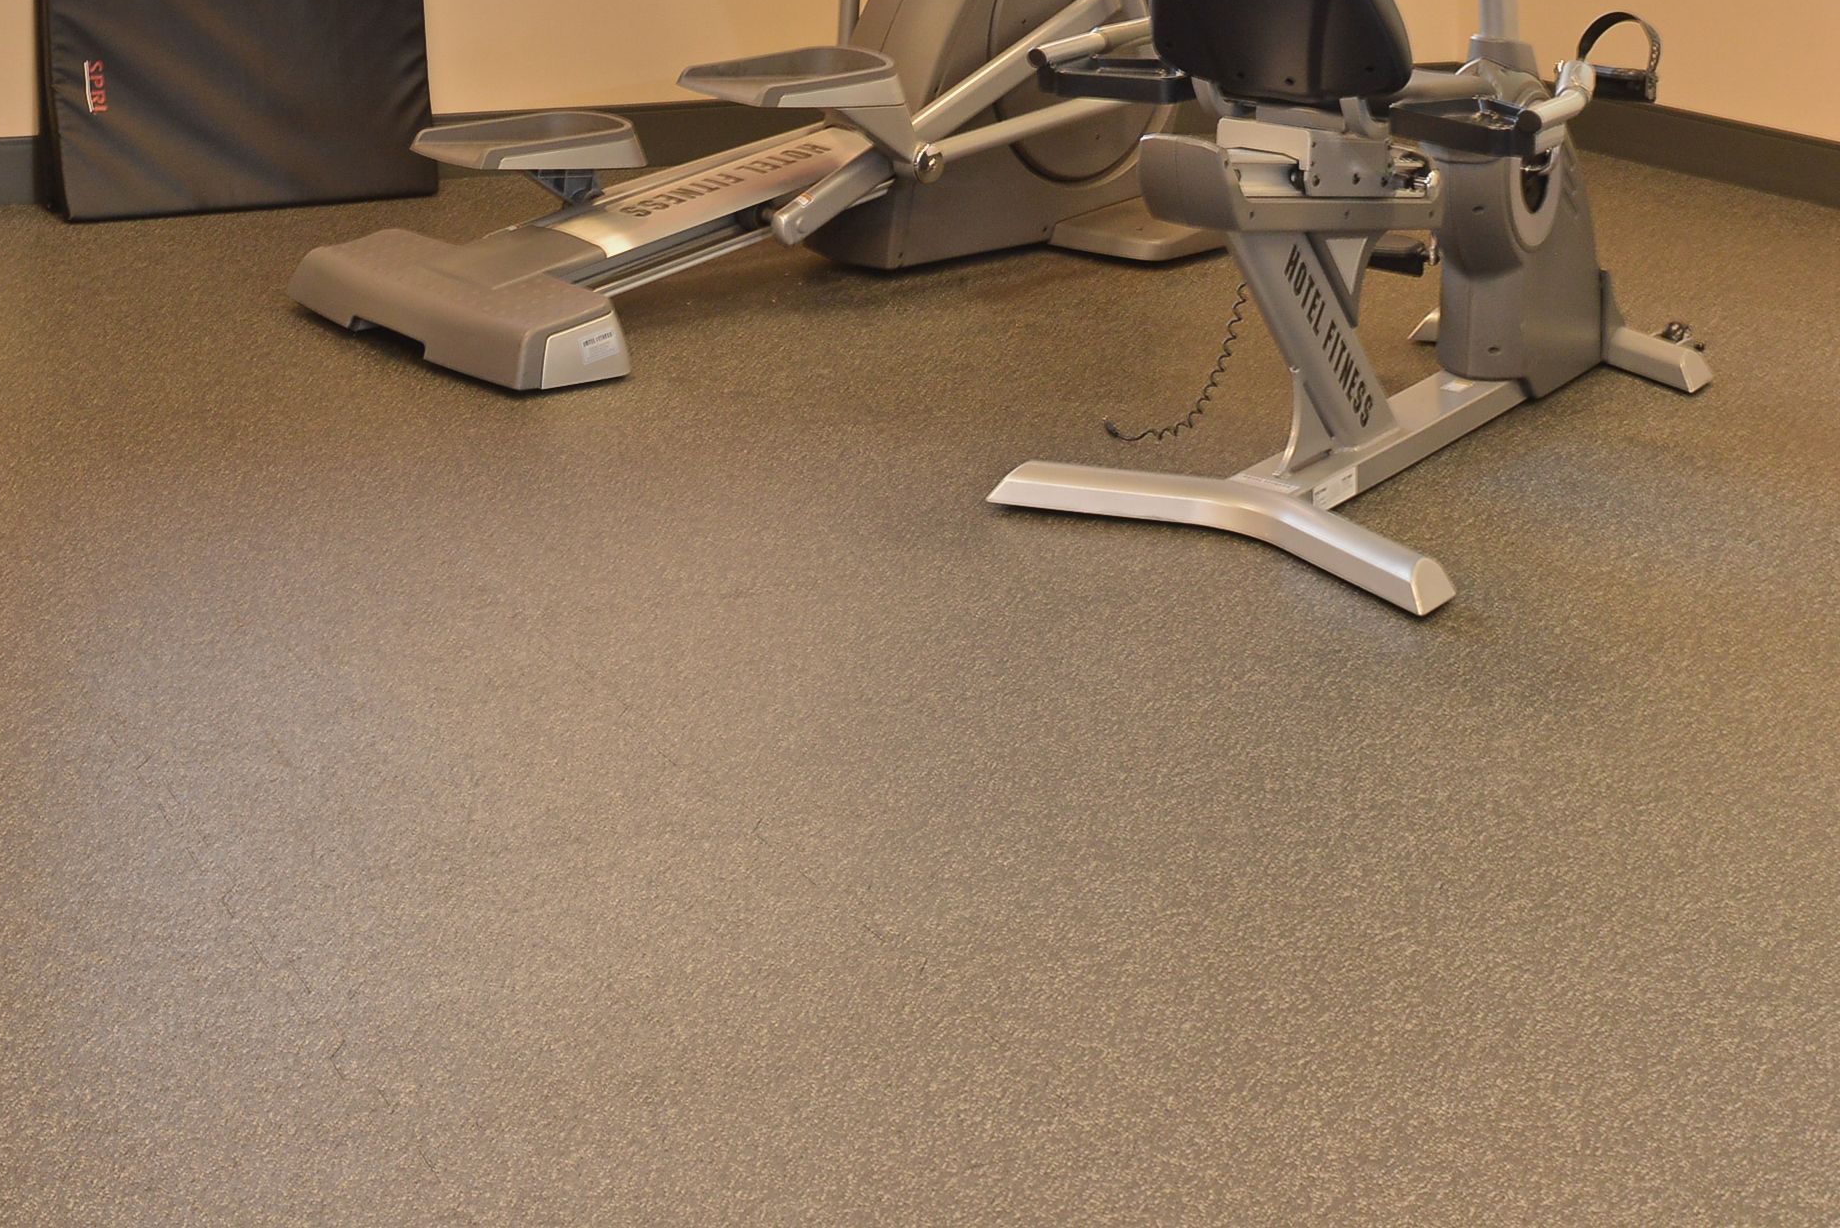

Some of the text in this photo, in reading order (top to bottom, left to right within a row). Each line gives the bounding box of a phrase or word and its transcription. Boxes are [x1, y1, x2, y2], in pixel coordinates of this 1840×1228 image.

[89, 60, 108, 112] SPRI
[619, 142, 832, 218] HOTEL FITNESS
[1284, 244, 1326, 337] HOTEL
[1322, 319, 1373, 428] FITNESS
